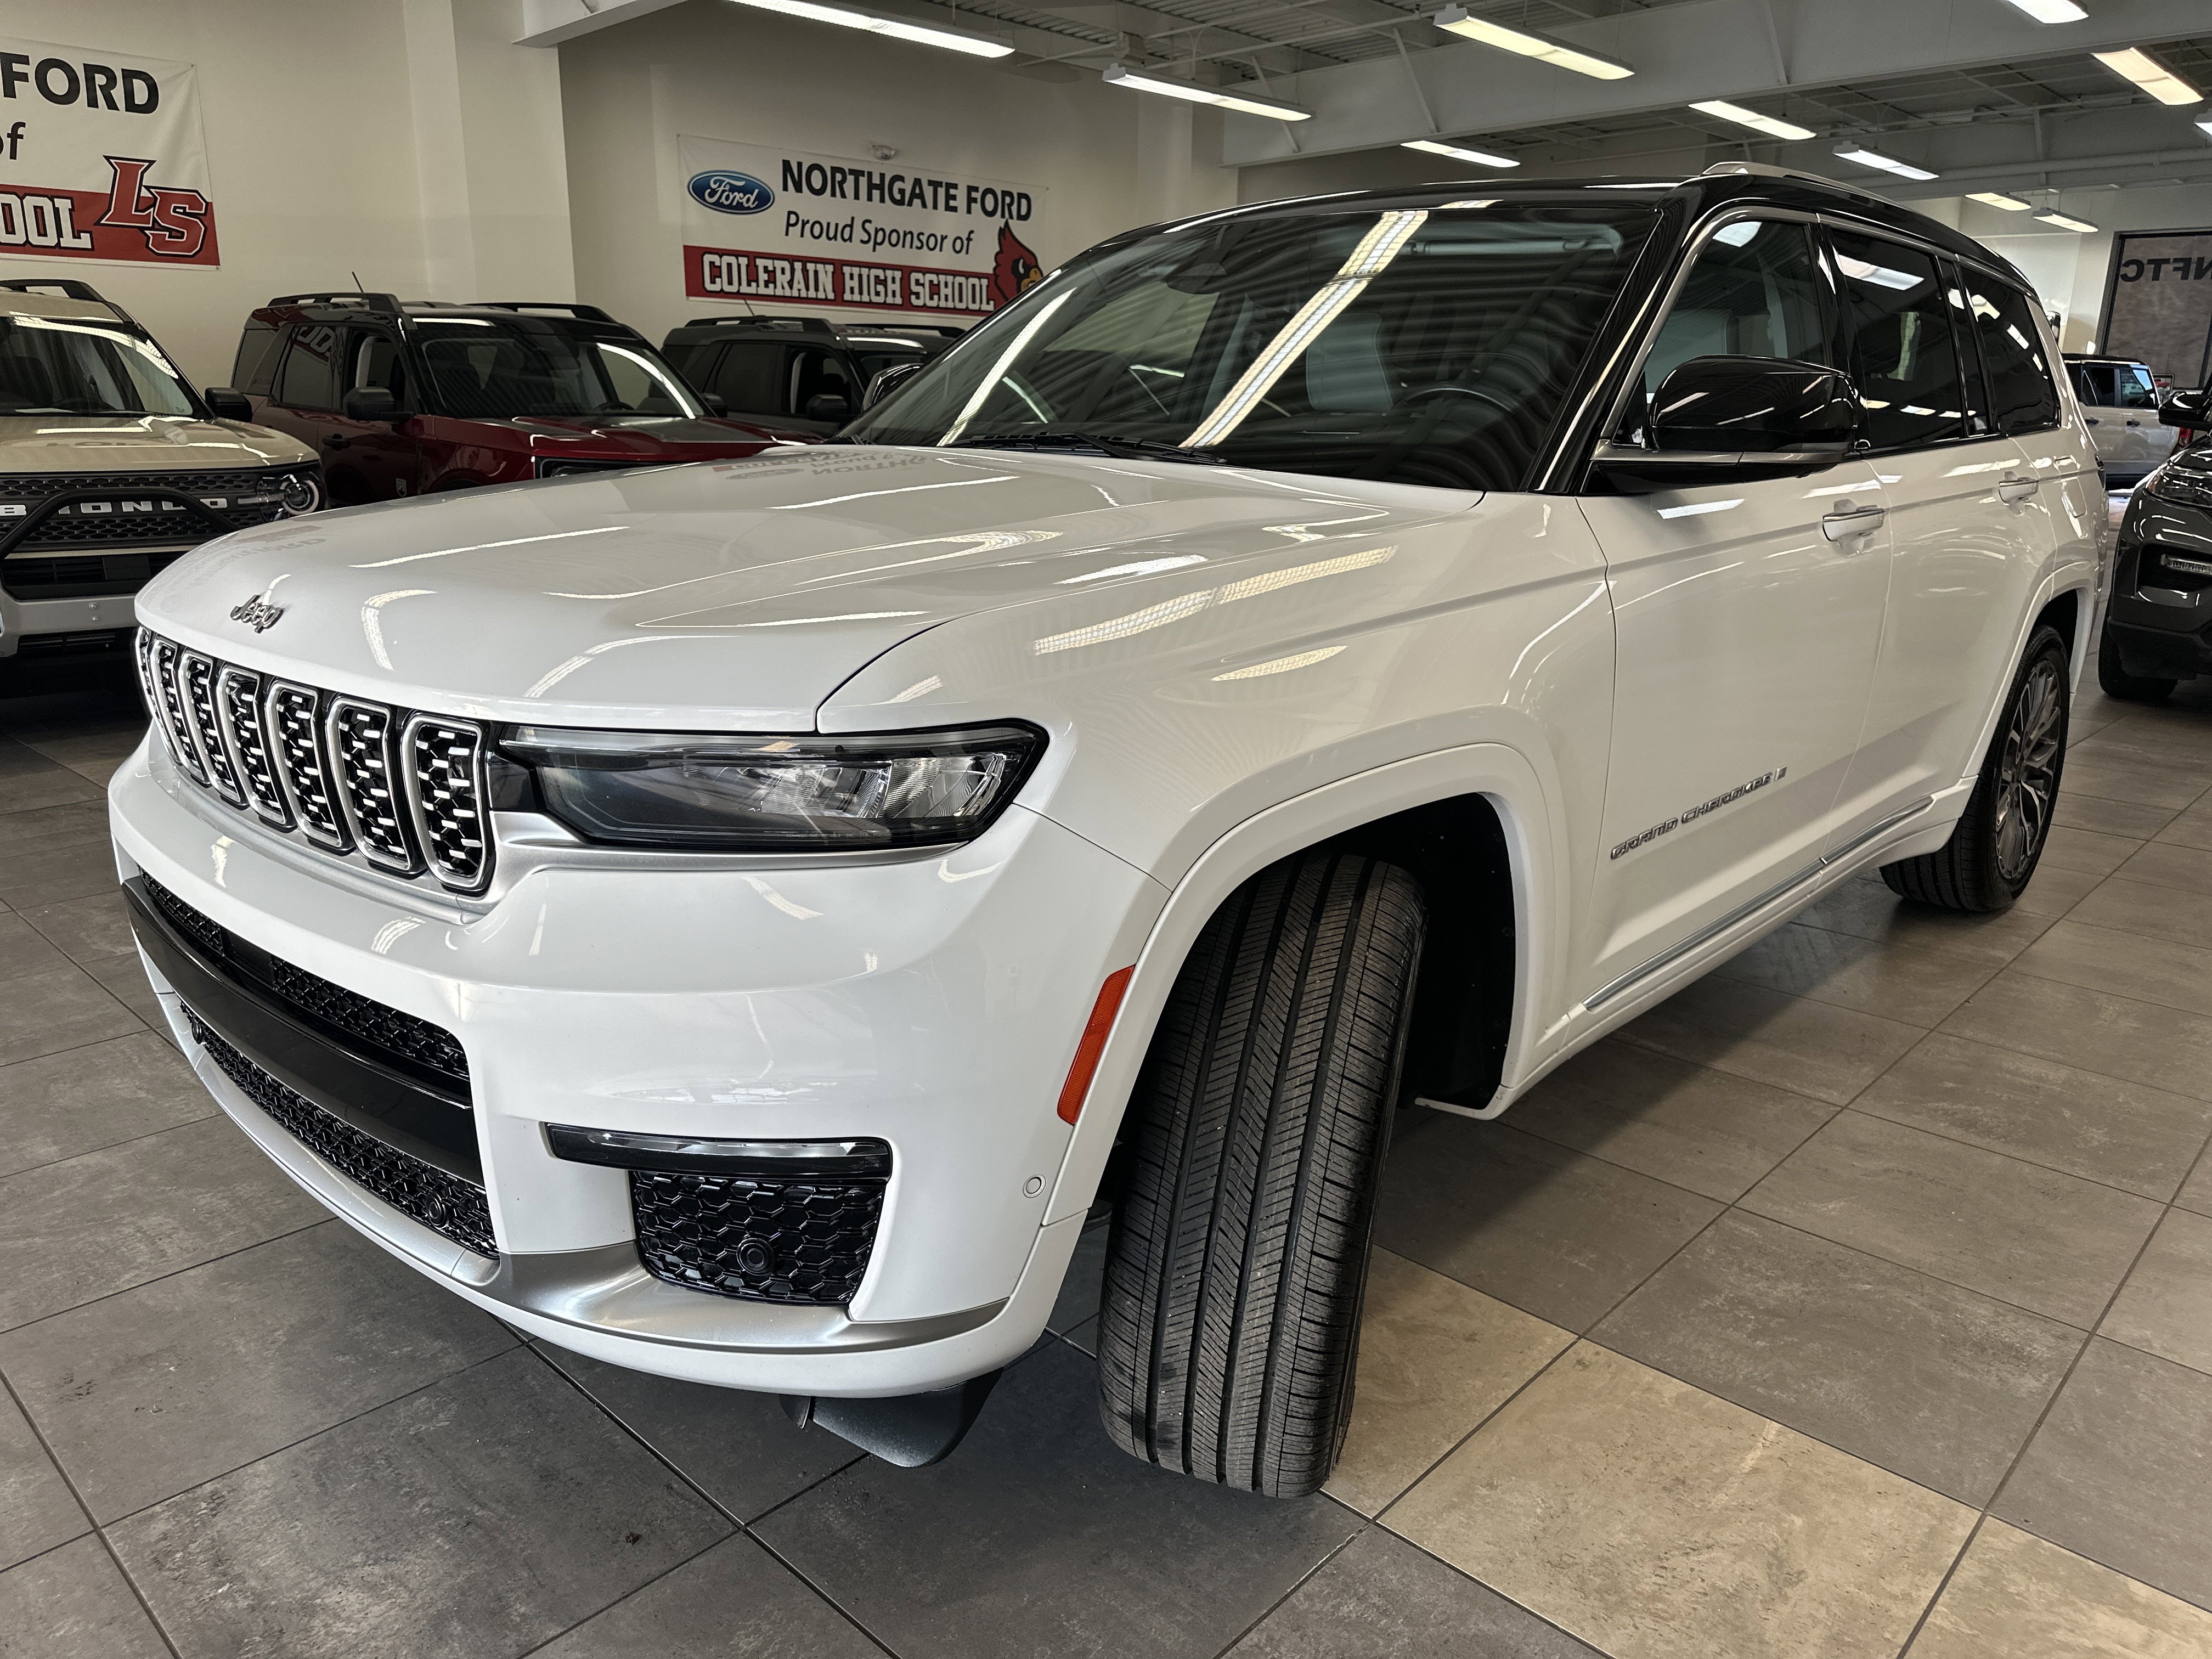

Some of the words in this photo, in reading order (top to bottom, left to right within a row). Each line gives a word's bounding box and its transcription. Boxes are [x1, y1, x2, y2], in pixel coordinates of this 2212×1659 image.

[0, 52, 159, 114] FORD
[704, 176, 760, 208] Ford
[782, 159, 958, 213] NORTHGATE
[966, 184, 1032, 222] FORD
[785, 210, 855, 243] Proud
[860, 218, 949, 253] Sponsor
[952, 229, 975, 255] of
[702, 252, 836, 301] COLERAIN
[842, 265, 904, 305] HIGH
[909, 272, 995, 312] SCHOOL
[230, 594, 284, 634] Jeep
[1610, 817, 1679, 861] GRAND
[1681, 771, 1774, 825] CHEROKEE
